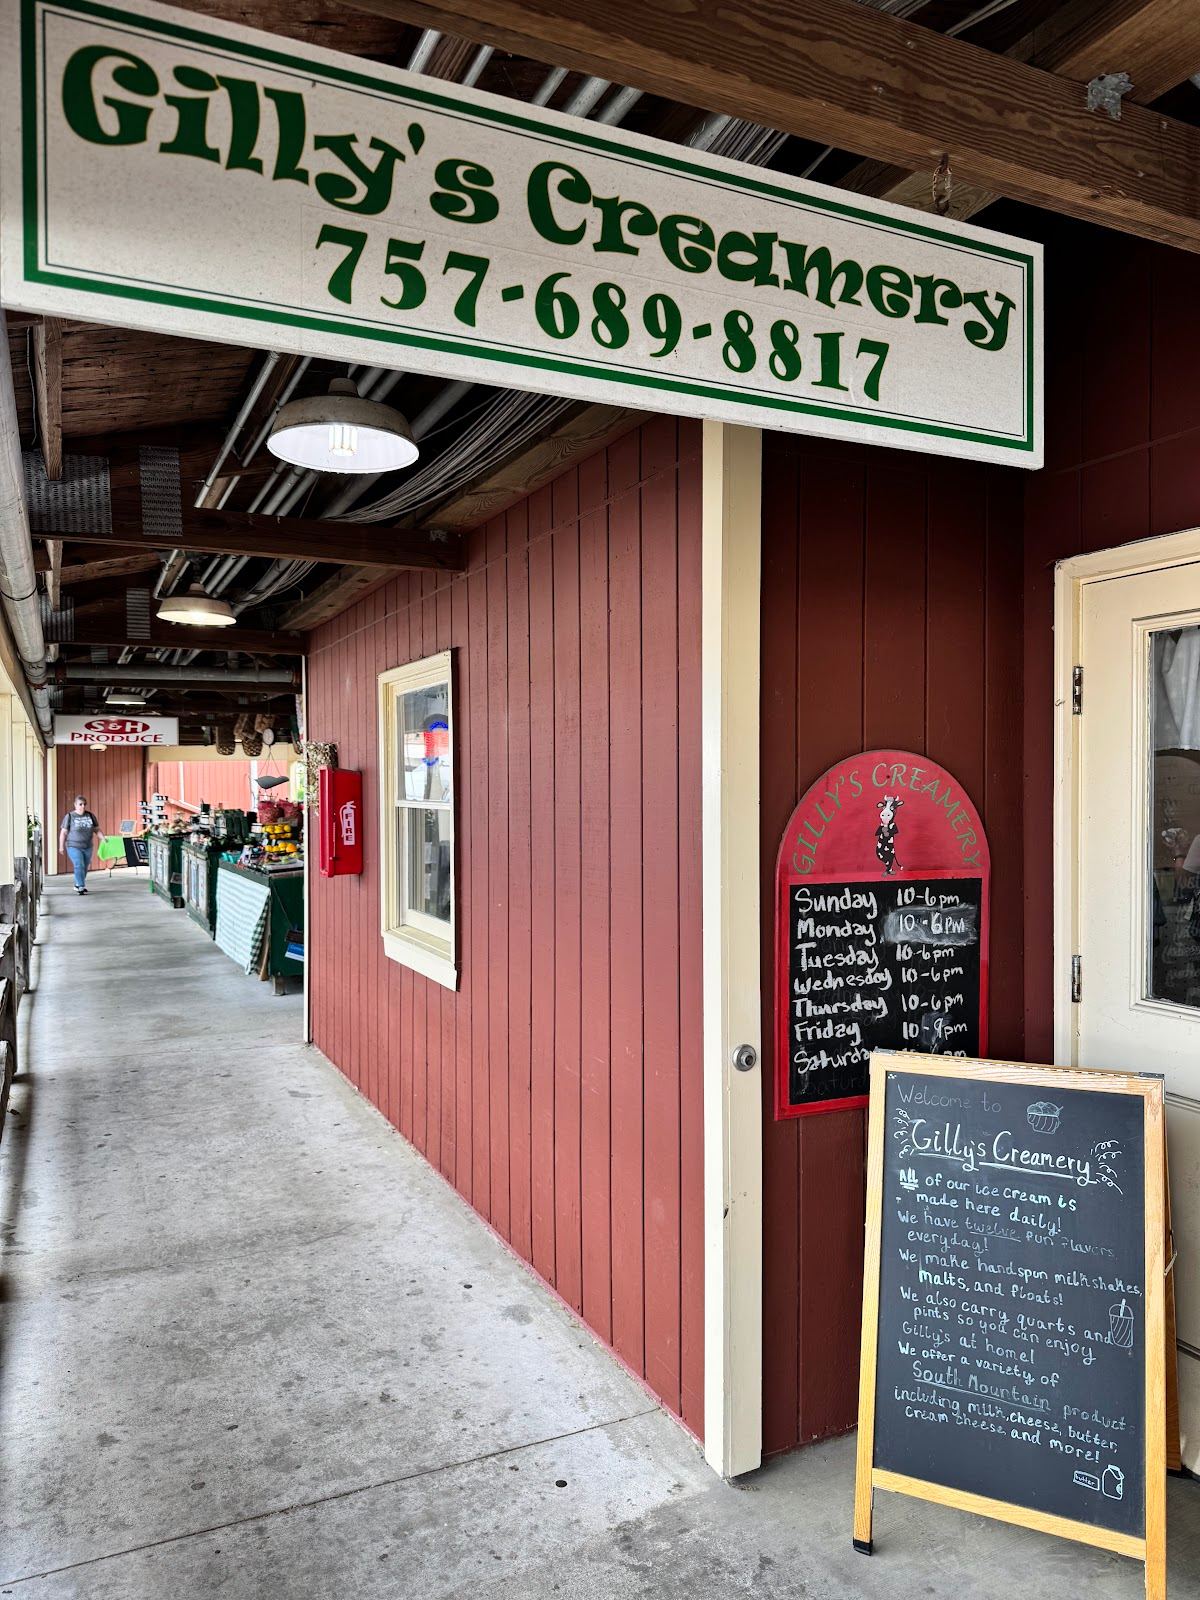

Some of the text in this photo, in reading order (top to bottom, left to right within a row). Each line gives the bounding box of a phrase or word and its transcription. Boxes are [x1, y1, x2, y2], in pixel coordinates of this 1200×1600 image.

[61, 44, 1016, 351] Gilly's Creamery
[315, 224, 890, 402] 757-689-8817
[70, 732, 163, 743] PRODUCE
[345, 812, 353, 841] FIRE
[793, 763, 983, 875] GILLY'S CREAMERY
[795, 887, 878, 920] Sunday
[797, 918, 877, 947] Monday
[795, 942, 879, 973] Tuesday
[794, 968, 893, 995] Wednesday
[792, 993, 889, 1019] Thursday
[794, 1019, 862, 1047] Friday
[794, 1047, 870, 1075] Saturda
[897, 1084, 1001, 1112] Welcome to
[911, 1119, 1098, 1187] Gilly's Creamery
[925, 1173, 943, 1186] of
[946, 1180, 970, 1190] our
[975, 1184, 1000, 1196] ice
[1003, 1187, 1052, 1205] cream
[1058, 1194, 1077, 1211] is
[897, 1210, 918, 1224] We
[924, 1210, 959, 1228] have
[1026, 1231, 1054, 1246] fun
[916, 1193, 1061, 1236] made here daily!
[899, 1248, 917, 1263] We
[925, 1254, 970, 1269] make
[978, 1258, 1048, 1283] handspun
[973, 1281, 1005, 1296] and
[1011, 1284, 1063, 1306] floats!
[900, 1286, 1114, 1346] We also carry quarts and
[902, 1321, 951, 1348] Gilly's
[959, 1333, 977, 1349] at
[913, 1305, 1096, 1365] pints so you can enjoy
[898, 1341, 1059, 1388] We offer a variety of
[912, 1360, 963, 1387] South
[968, 1374, 1051, 1411] Mountain
[894, 1386, 960, 1416] including
[1068, 1425, 1118, 1453] butter,
[905, 1405, 949, 1423] cream
[1010, 1427, 1042, 1446] and
[1049, 1438, 1100, 1463] more!
[1075, 1473, 1096, 1486] butter
